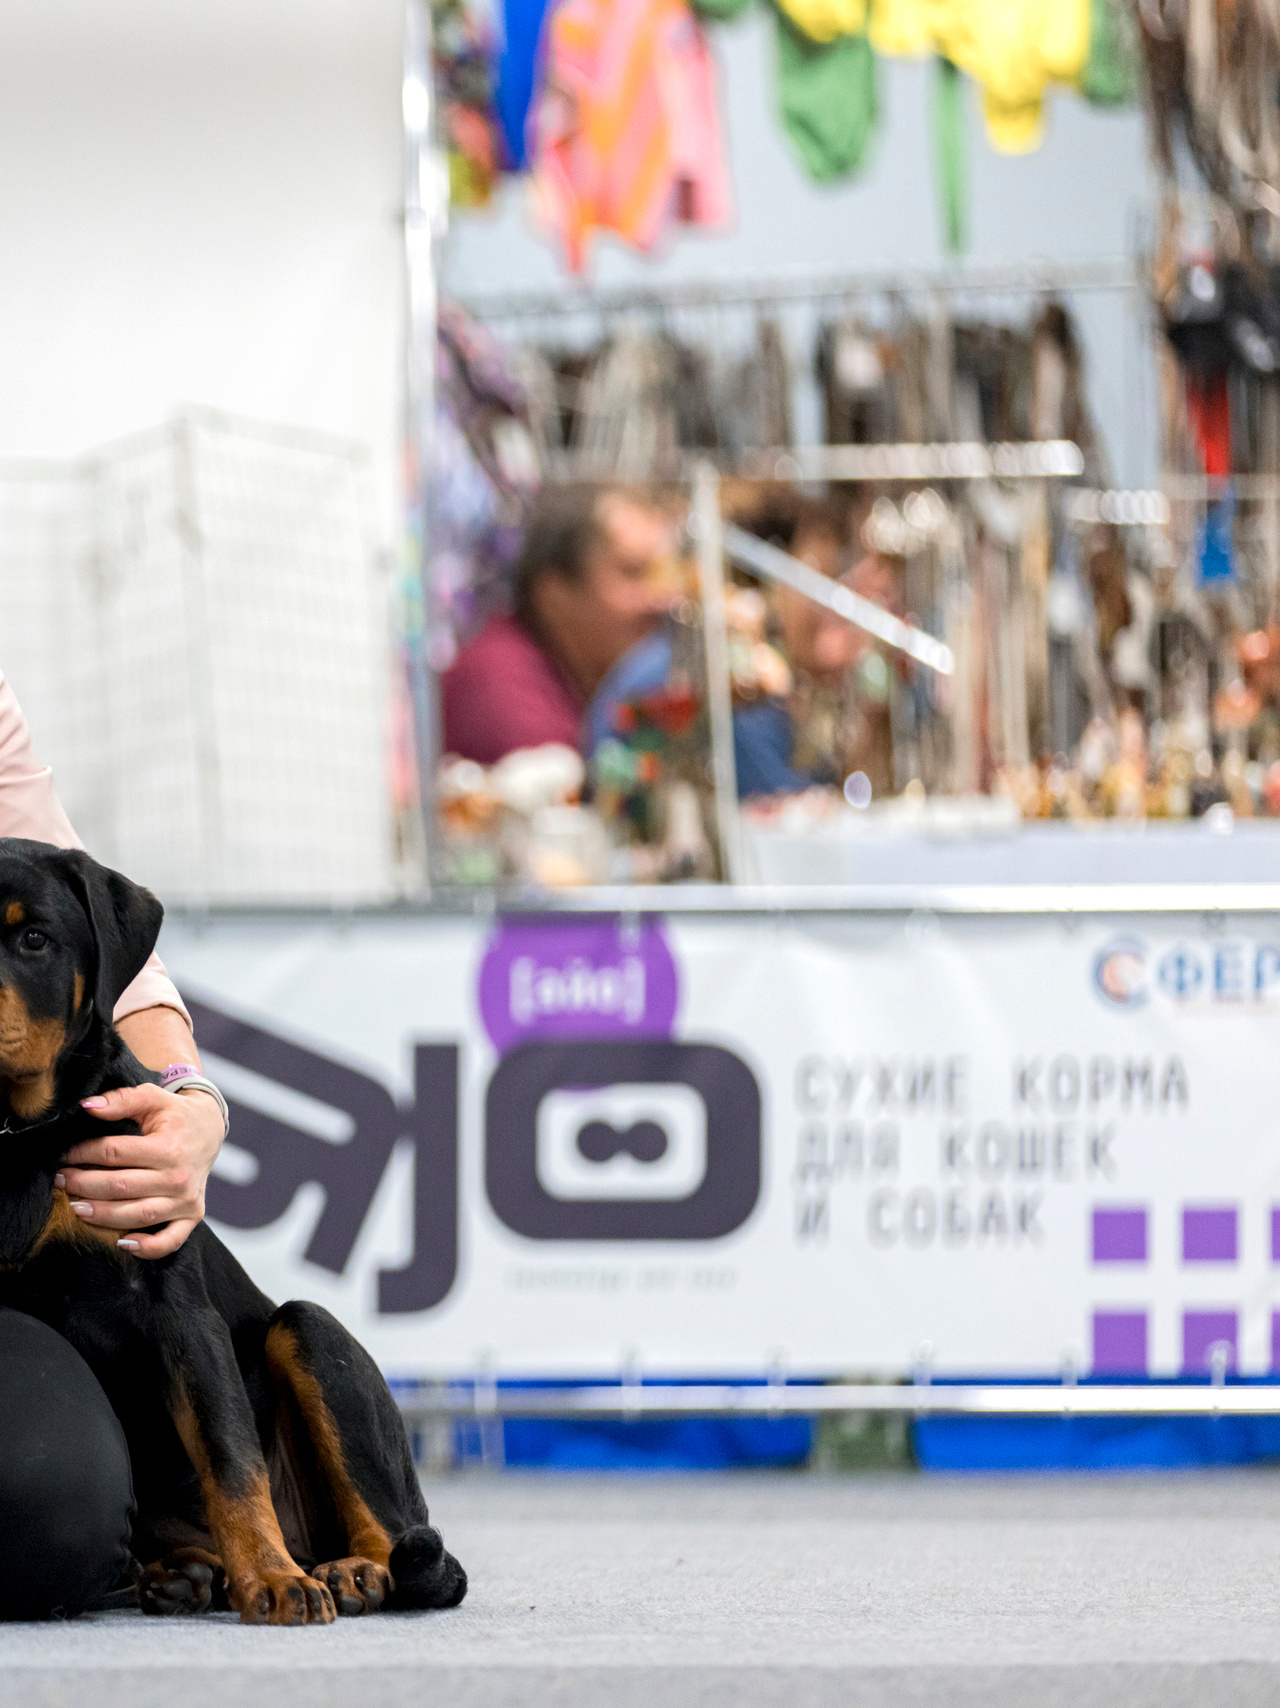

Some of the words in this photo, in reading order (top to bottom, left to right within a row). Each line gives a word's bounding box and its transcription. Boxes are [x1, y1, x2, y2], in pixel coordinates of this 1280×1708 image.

[794, 1053, 968, 1115] СУХИЕ
[1012, 1053, 1190, 1114] КОРМА
[794, 1119, 901, 1182] ДЛЯ
[940, 1119, 1119, 1182] КОШЕК
[794, 1187, 830, 1250] И
[867, 1186, 1045, 1250] СОБАК
